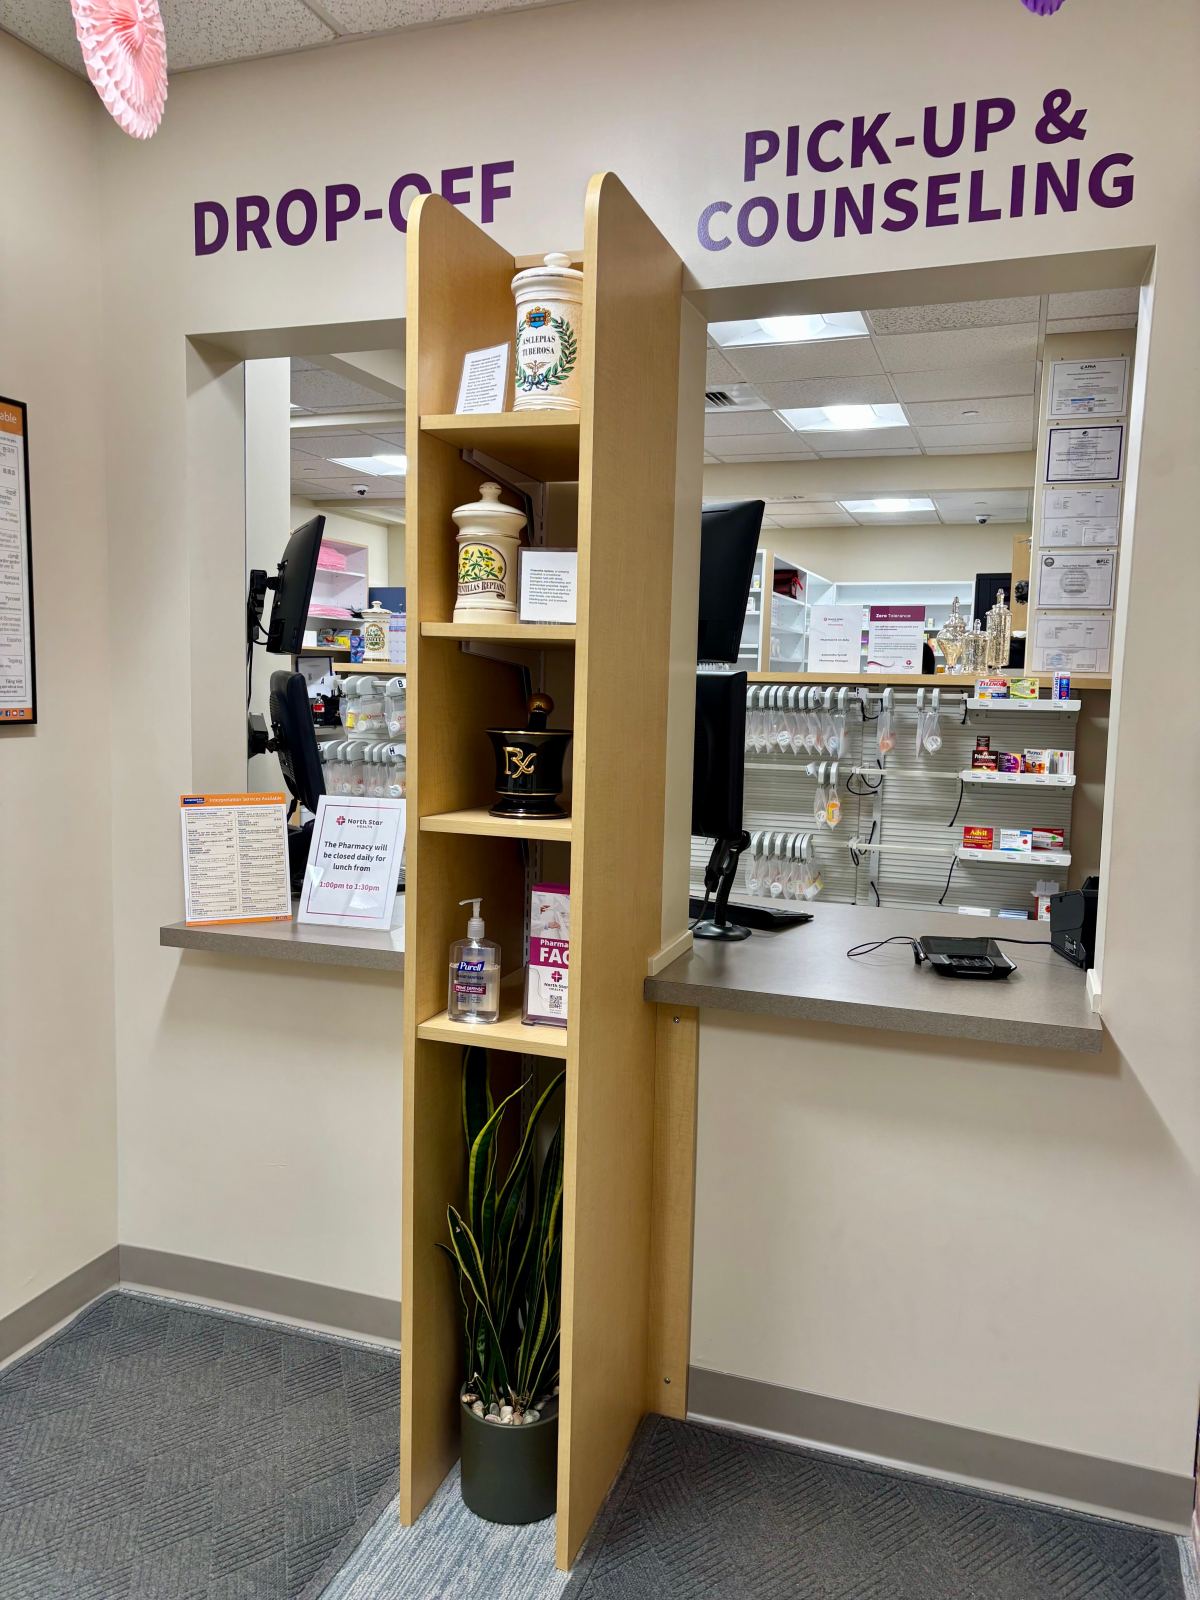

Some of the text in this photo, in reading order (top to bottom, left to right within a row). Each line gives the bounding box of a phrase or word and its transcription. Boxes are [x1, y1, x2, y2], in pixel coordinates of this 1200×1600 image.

[744, 88, 1088, 182] PICK-UP &
[697, 152, 1134, 252] COUNSELING
[194, 160, 514, 256] DROP-OFF
[338, 842, 373, 851] Pharmacy
[357, 854, 374, 862] daily
[320, 882, 344, 890] 1:00pm
[354, 883, 379, 892] 1:30pm
[540, 939, 568, 948] Pharma
[460, 961, 482, 971] Purell
